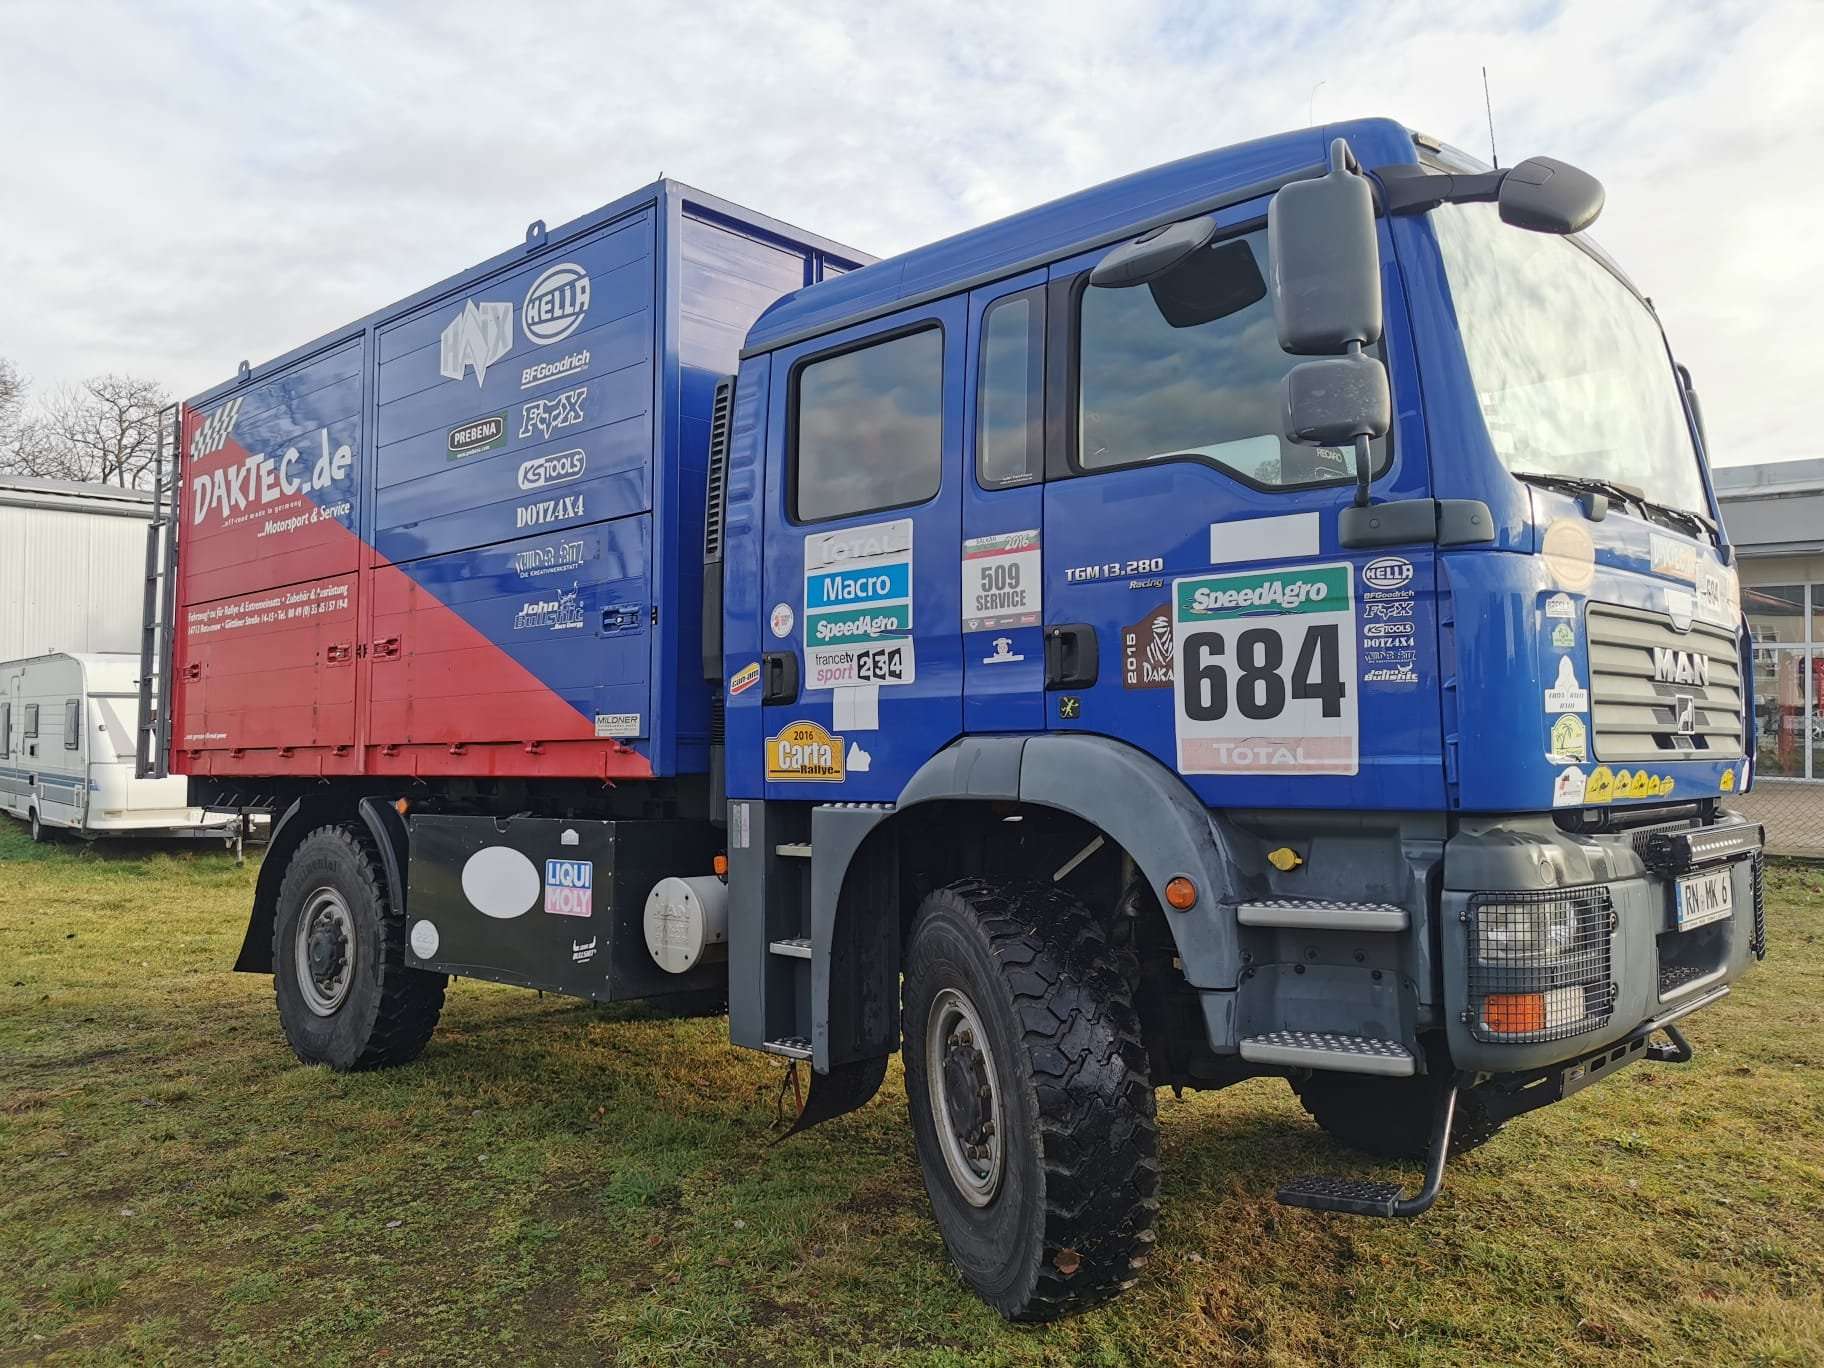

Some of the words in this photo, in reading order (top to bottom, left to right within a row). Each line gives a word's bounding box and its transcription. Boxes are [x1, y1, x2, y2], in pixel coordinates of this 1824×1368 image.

[527, 276, 590, 324] HELLA
[521, 350, 590, 384] BFGoodrich
[454, 422, 497, 446] PREBENA
[193, 427, 352, 526] DAKTEC.de
[521, 463, 544, 485] KS
[544, 456, 581, 478] TOOLS
[310, 507, 318, 523] &
[320, 501, 351, 520] Service
[516, 495, 584, 528] DOTZ4X4
[980, 562, 1021, 593] 509
[1065, 565, 1100, 582] TGM
[1102, 557, 1164, 577] 13.280
[1366, 564, 1414, 579] HELLA
[823, 575, 891, 602] Macro
[1129, 577, 1164, 589] Racing
[1192, 579, 1328, 609] SpeedAgro
[1363, 589, 1415, 600] BFGoodrich
[519, 601, 559, 616] John
[975, 589, 1027, 612] SERVICE
[815, 615, 898, 641] SpeedAgro
[1367, 625, 1384, 634] KS
[1384, 624, 1411, 633] TOOLS
[1363, 637, 1415, 648] DOTZ4X4
[816, 651, 855, 666] francetv
[1653, 646, 1709, 687] MAN
[816, 665, 855, 687] sport
[1143, 662, 1175, 683] DAKA
[1183, 623, 1346, 722] 684
[598, 716, 638, 724] MILDNER
[793, 730, 814, 741] 2016
[778, 740, 833, 770] Carta
[1213, 741, 1313, 766] TOTAL
[800, 764, 834, 775] Rallye
[547, 863, 590, 888] LIQUI
[547, 889, 591, 914] MOLY
[1685, 882, 1700, 916] RN
[1705, 879, 1719, 910] MK
[1722, 876, 1728, 905] 6
